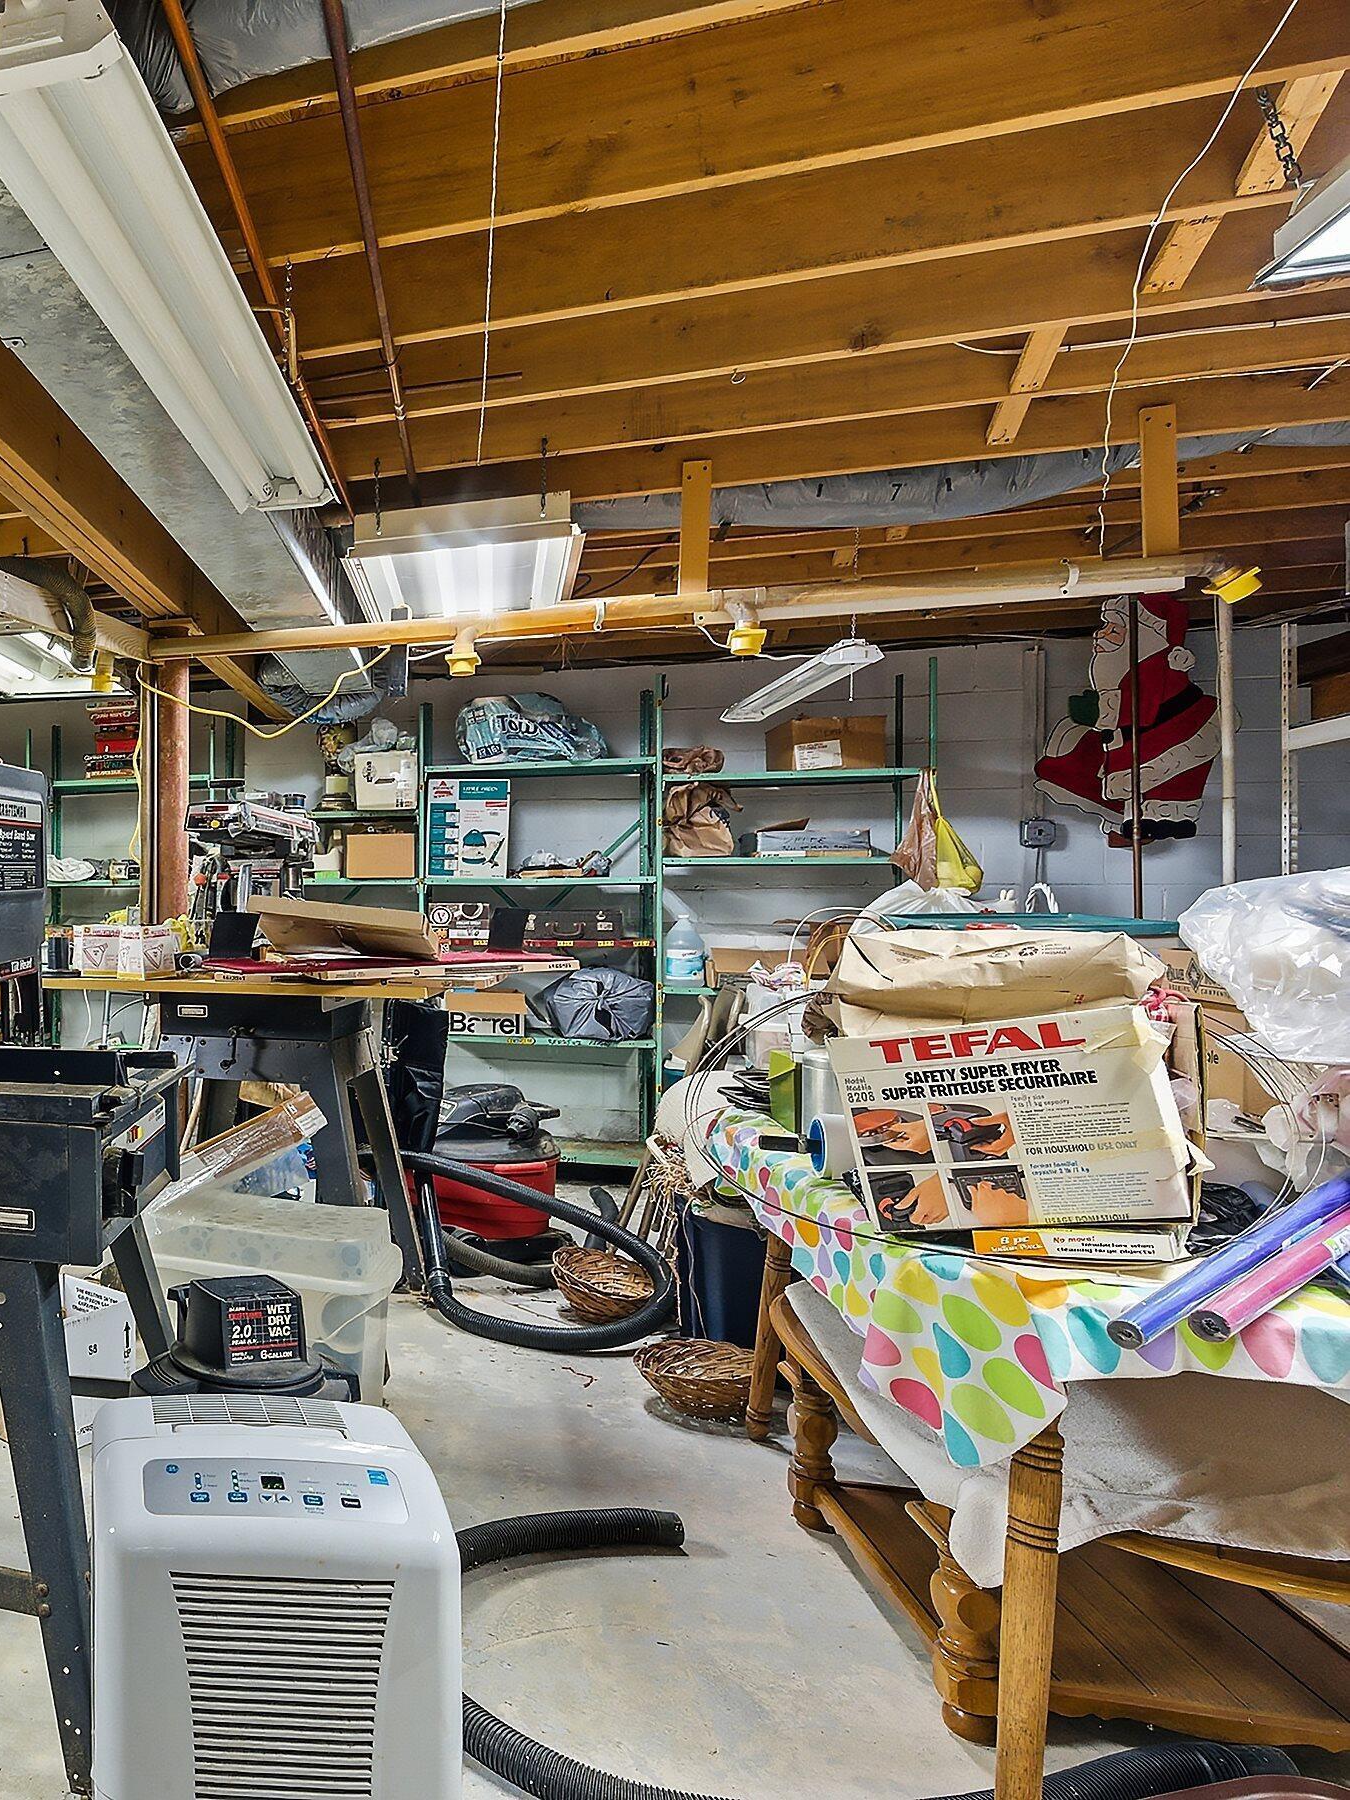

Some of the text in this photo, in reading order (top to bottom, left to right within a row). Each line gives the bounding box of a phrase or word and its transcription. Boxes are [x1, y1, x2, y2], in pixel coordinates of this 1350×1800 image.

[869, 1022, 1087, 1064] TEFAL
[905, 1059, 1062, 1085] SAFETY SUPER FRYER
[882, 1070, 1098, 1101] SUPER FRITEUSE SECURITAIRE
[847, 1091, 876, 1103] 8208
[1025, 1140, 1138, 1156] FOR HOUSEHOLD USE ONLY
[266, 1303, 292, 1315] WET
[267, 1314, 292, 1326] DRY
[231, 1325, 253, 1339] 2.0
[267, 1326, 291, 1337] VAC
[260, 1350, 268, 1360] 6
